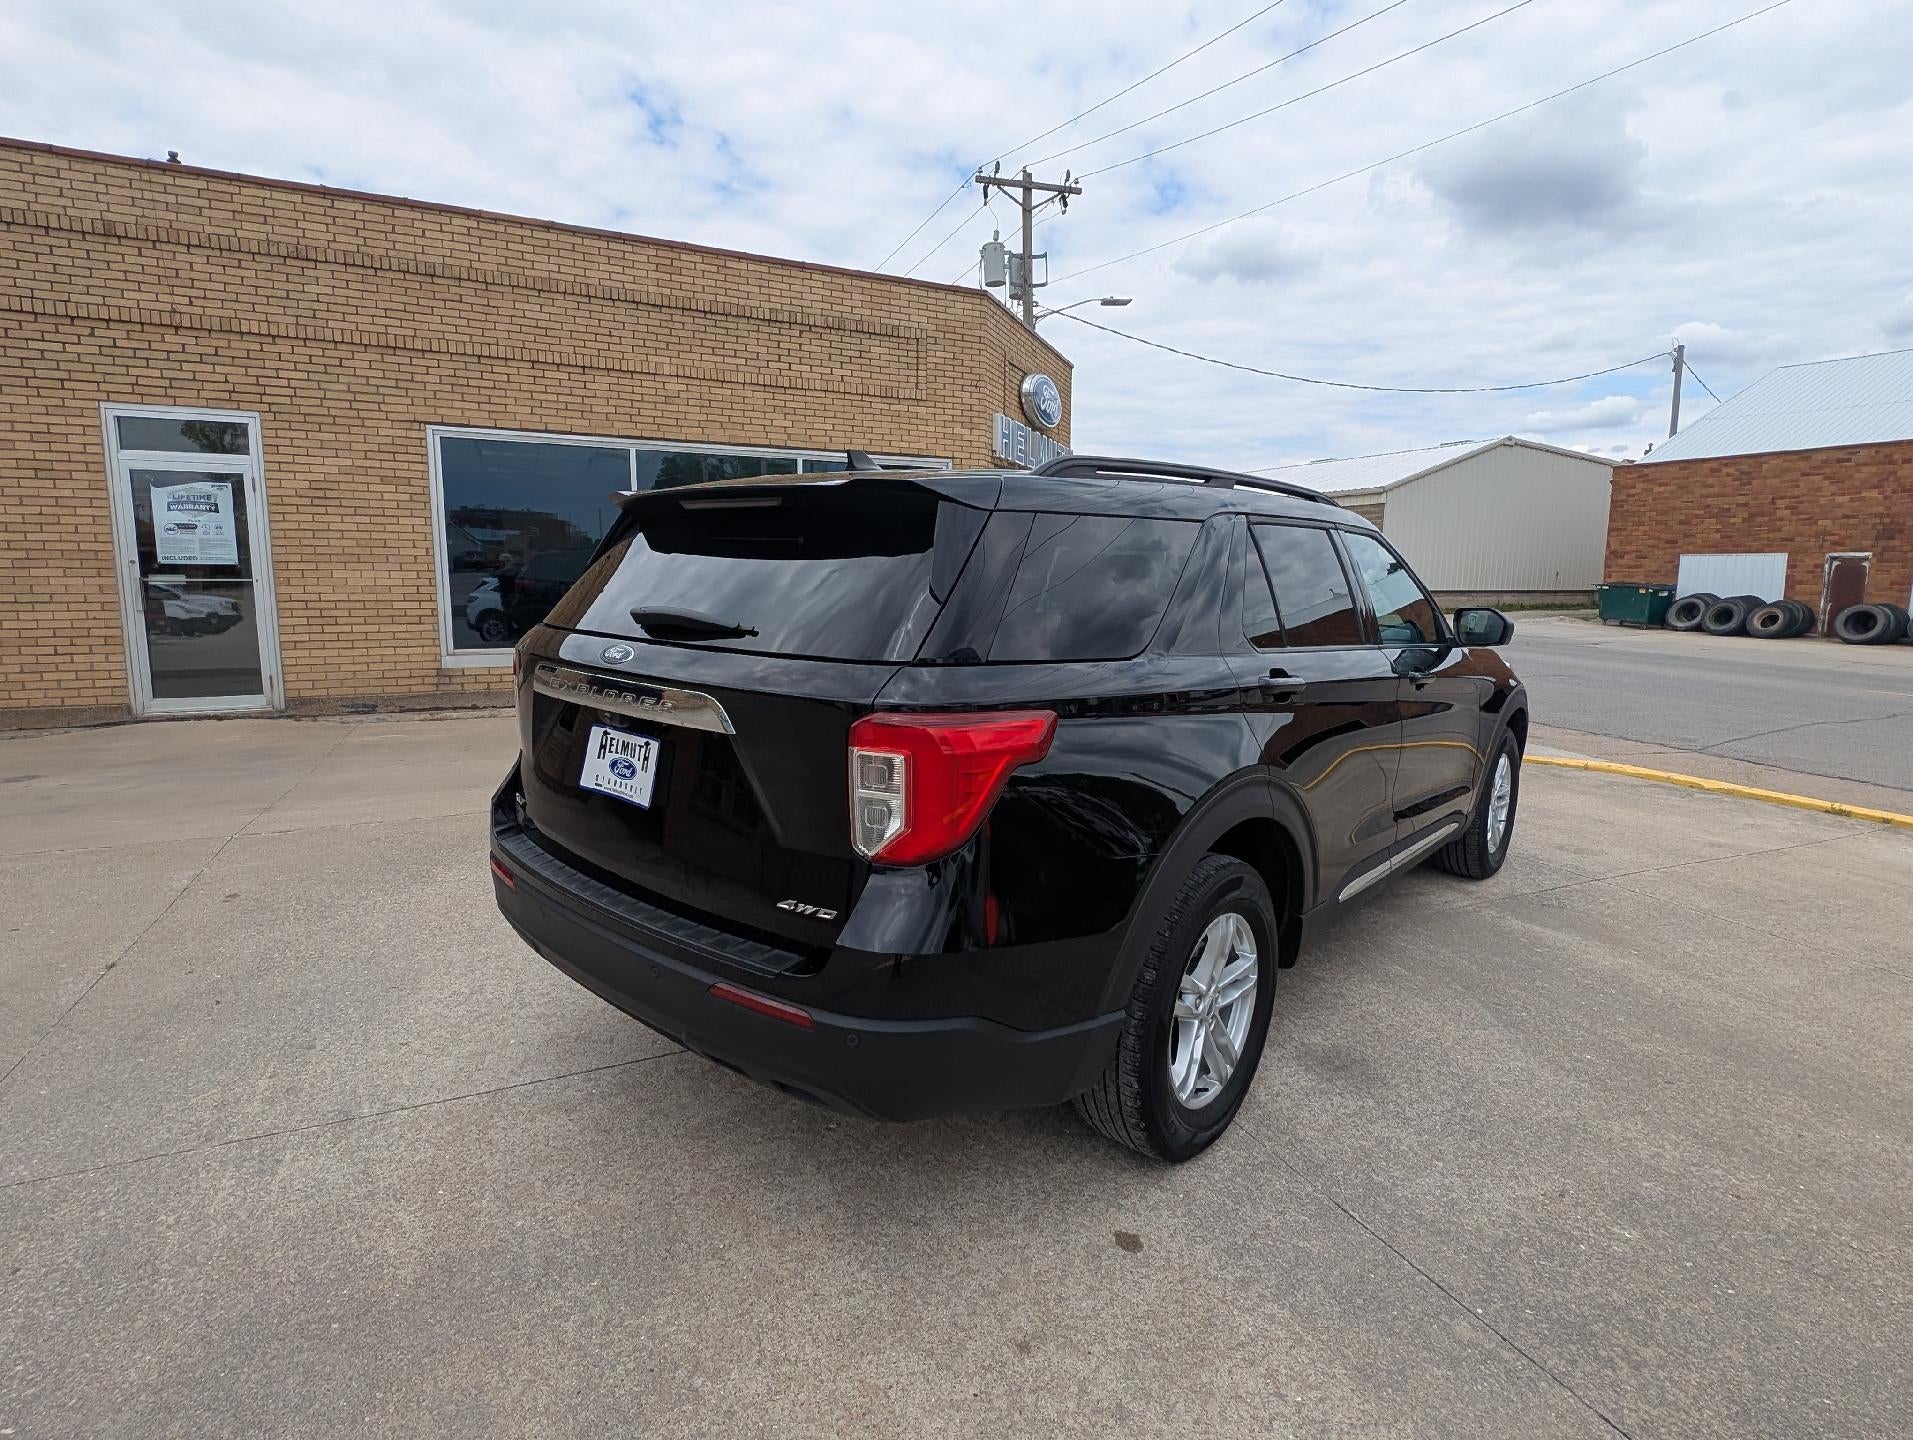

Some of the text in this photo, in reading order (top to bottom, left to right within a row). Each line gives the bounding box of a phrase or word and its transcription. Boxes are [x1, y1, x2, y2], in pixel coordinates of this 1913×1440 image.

[169, 503, 216, 512] WARRANTY
[549, 677, 676, 714] EXPLORER
[597, 730, 651, 773] HELMUTH
[776, 900, 838, 920] 4WD
